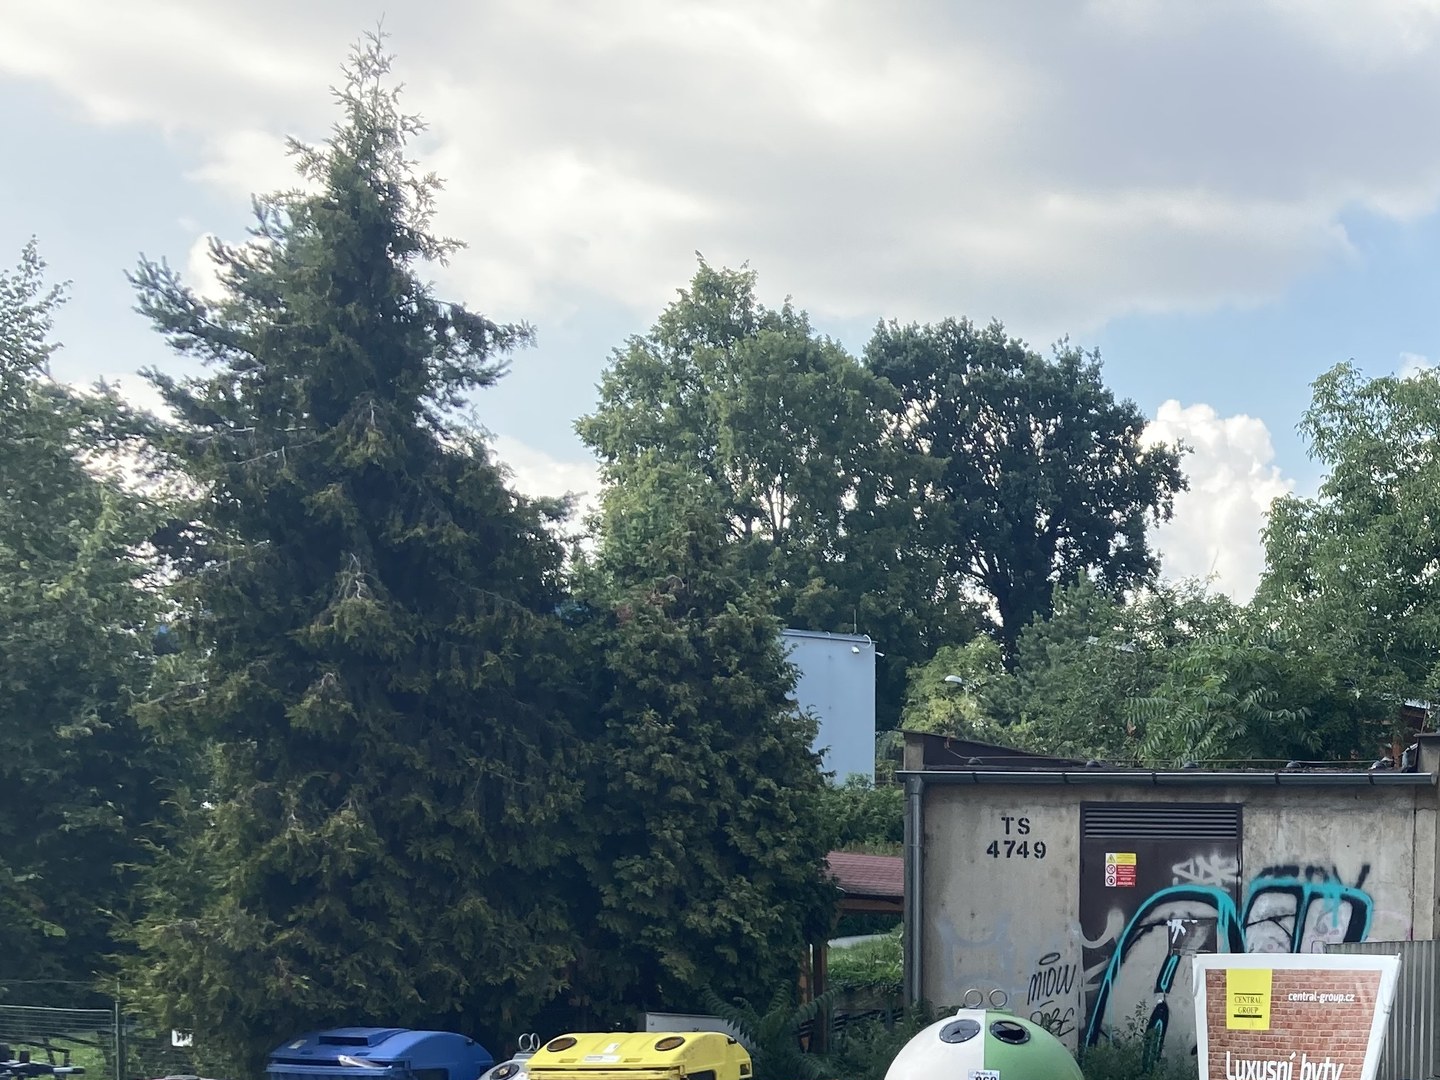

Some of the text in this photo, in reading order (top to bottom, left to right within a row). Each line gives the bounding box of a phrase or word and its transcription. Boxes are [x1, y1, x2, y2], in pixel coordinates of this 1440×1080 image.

[1000, 816, 1031, 835] TS
[986, 840, 1047, 859] 4749
[1234, 996, 1262, 1004] CENTRAL
[1288, 991, 1355, 1003] central-group.cz
